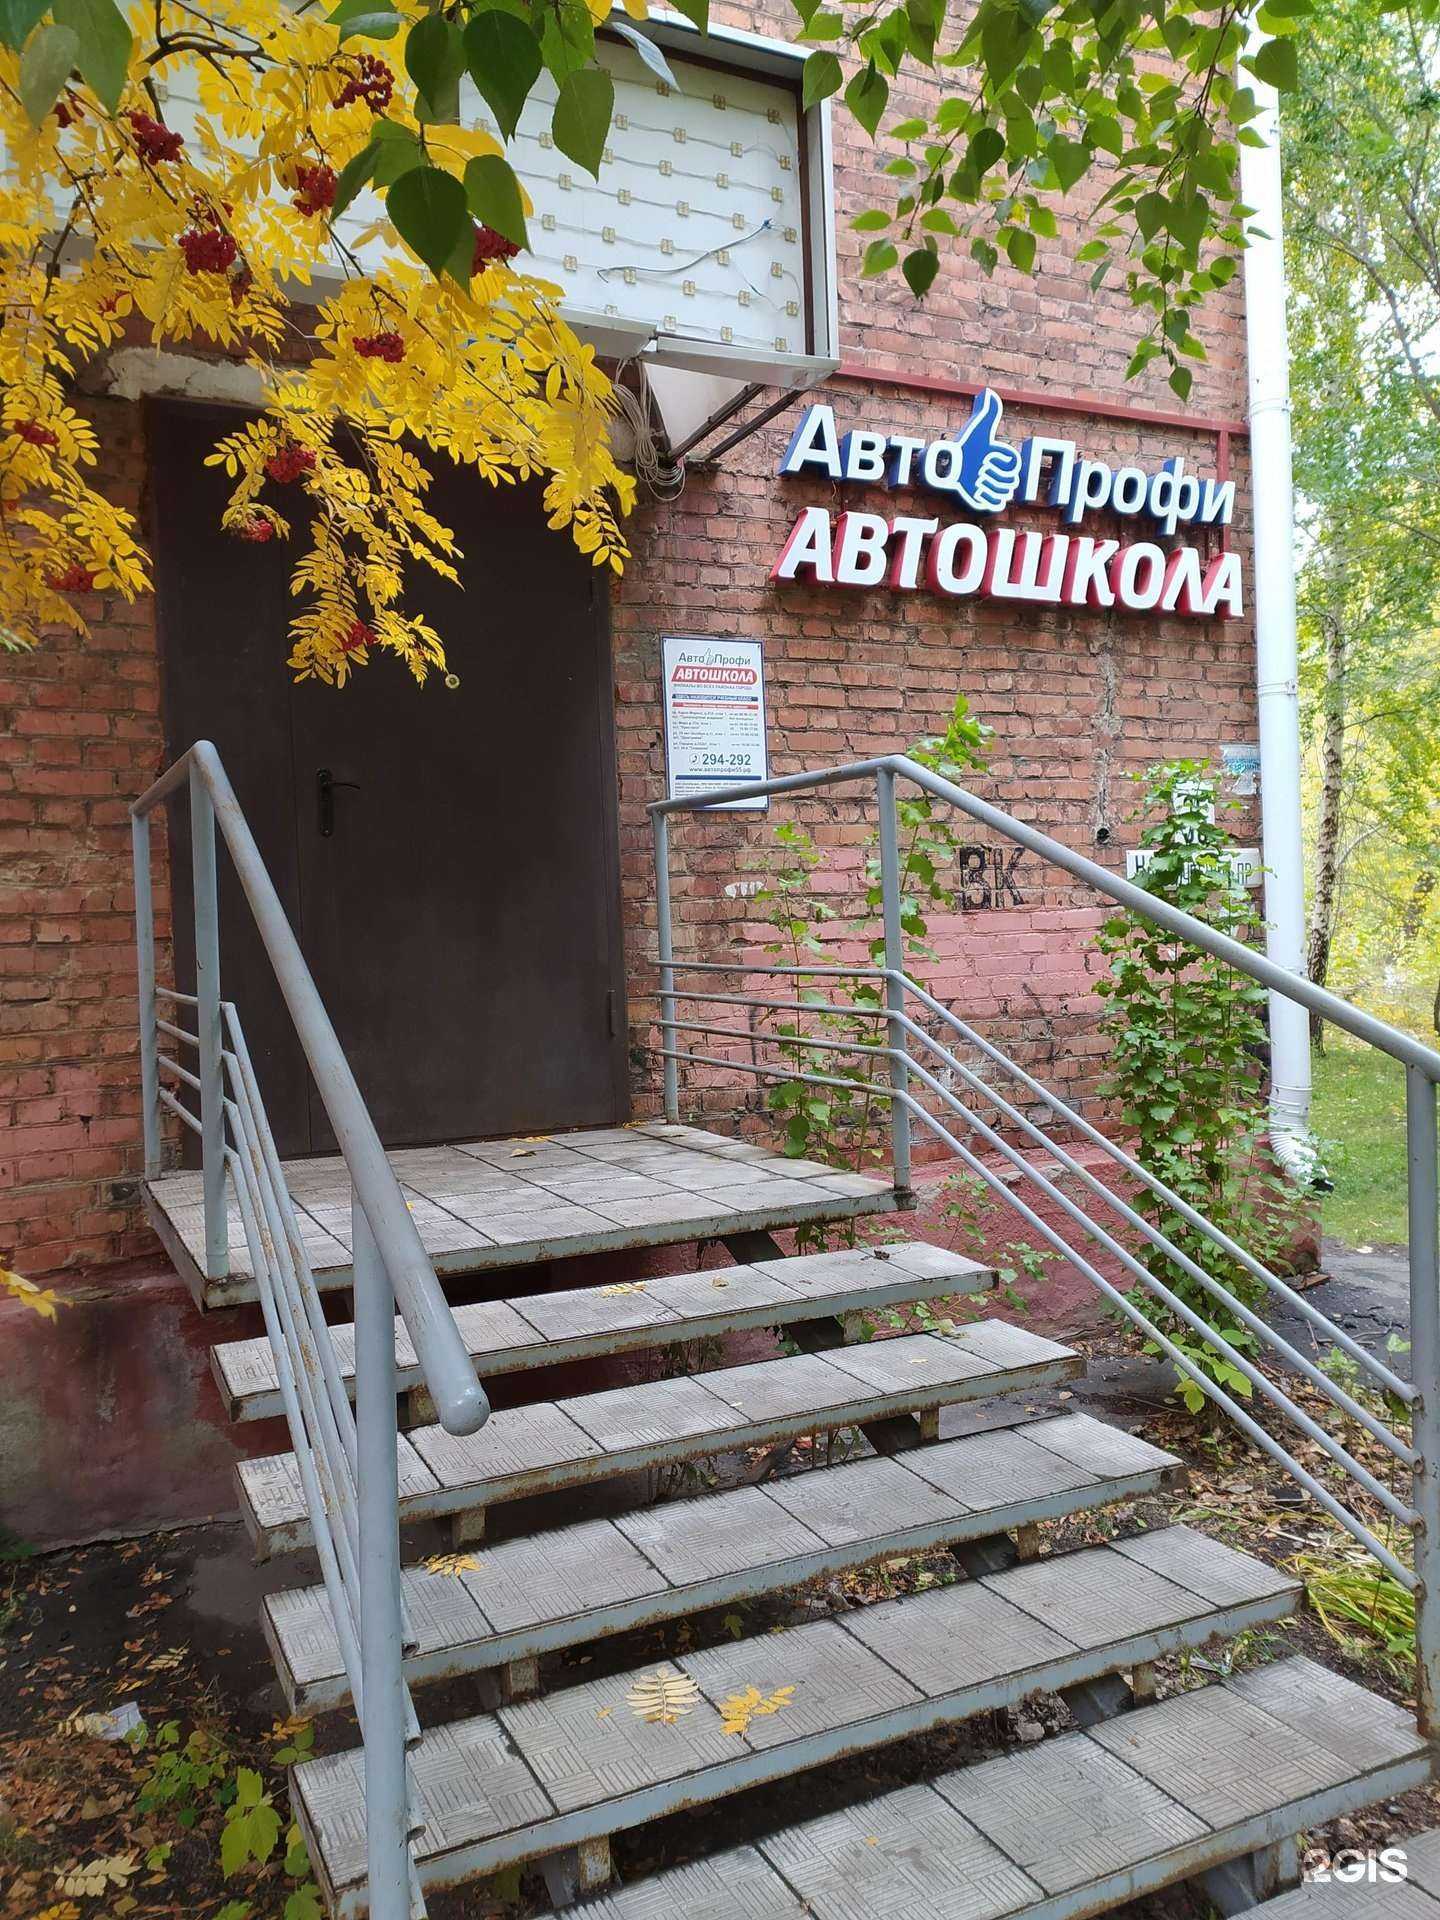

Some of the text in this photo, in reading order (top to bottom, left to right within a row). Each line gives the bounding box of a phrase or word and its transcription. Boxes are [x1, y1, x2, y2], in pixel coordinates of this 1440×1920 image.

[775, 506, 1245, 618] АВТОШКОЛА
[675, 668, 754, 683] АВТОШКОЛА
[702, 753, 751, 766] 294-292
